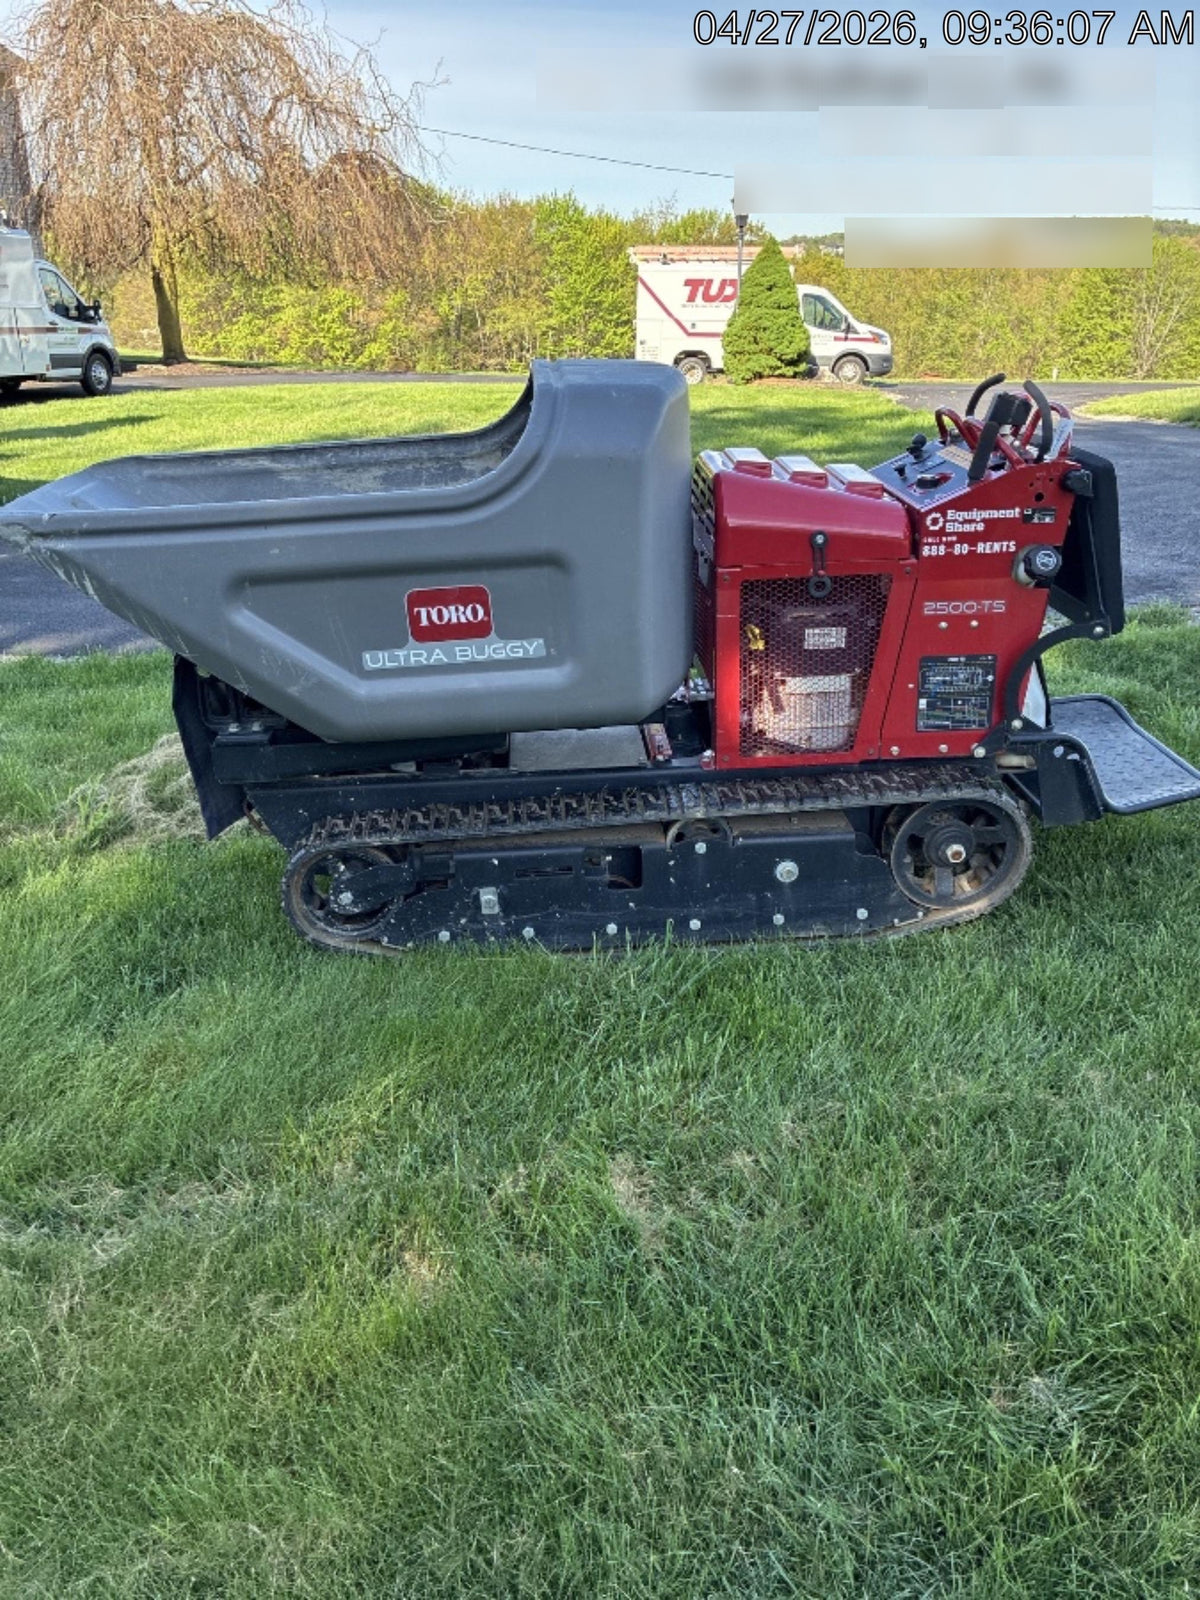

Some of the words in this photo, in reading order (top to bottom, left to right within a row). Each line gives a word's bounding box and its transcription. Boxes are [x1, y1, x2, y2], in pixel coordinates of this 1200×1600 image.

[947, 507, 1021, 521] Equipment
[945, 522, 985, 532] Share
[922, 541, 1016, 557] 888-80-RENTS
[413, 603, 486, 626] TORO
[923, 600, 1006, 615] 2500-TS
[365, 649, 447, 668] ULTRA
[455, 640, 539, 660] BUGGY
